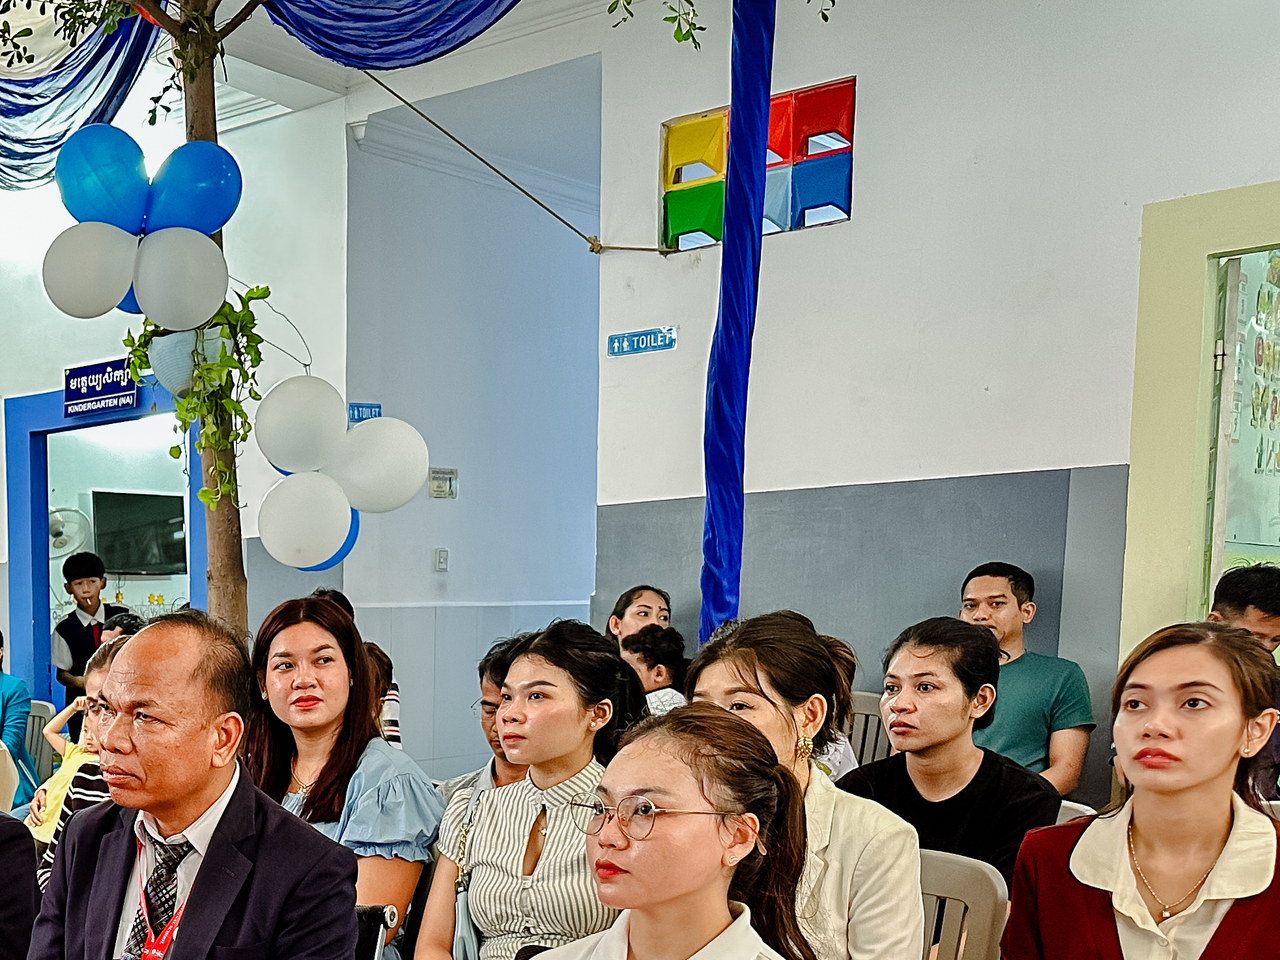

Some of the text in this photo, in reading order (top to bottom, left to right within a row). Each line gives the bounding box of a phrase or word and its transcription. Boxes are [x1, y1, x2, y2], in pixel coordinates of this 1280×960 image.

[633, 334, 671, 348] TOILET
[68, 398, 117, 413] KINDERGARTEN
[359, 407, 379, 418] TOILET
